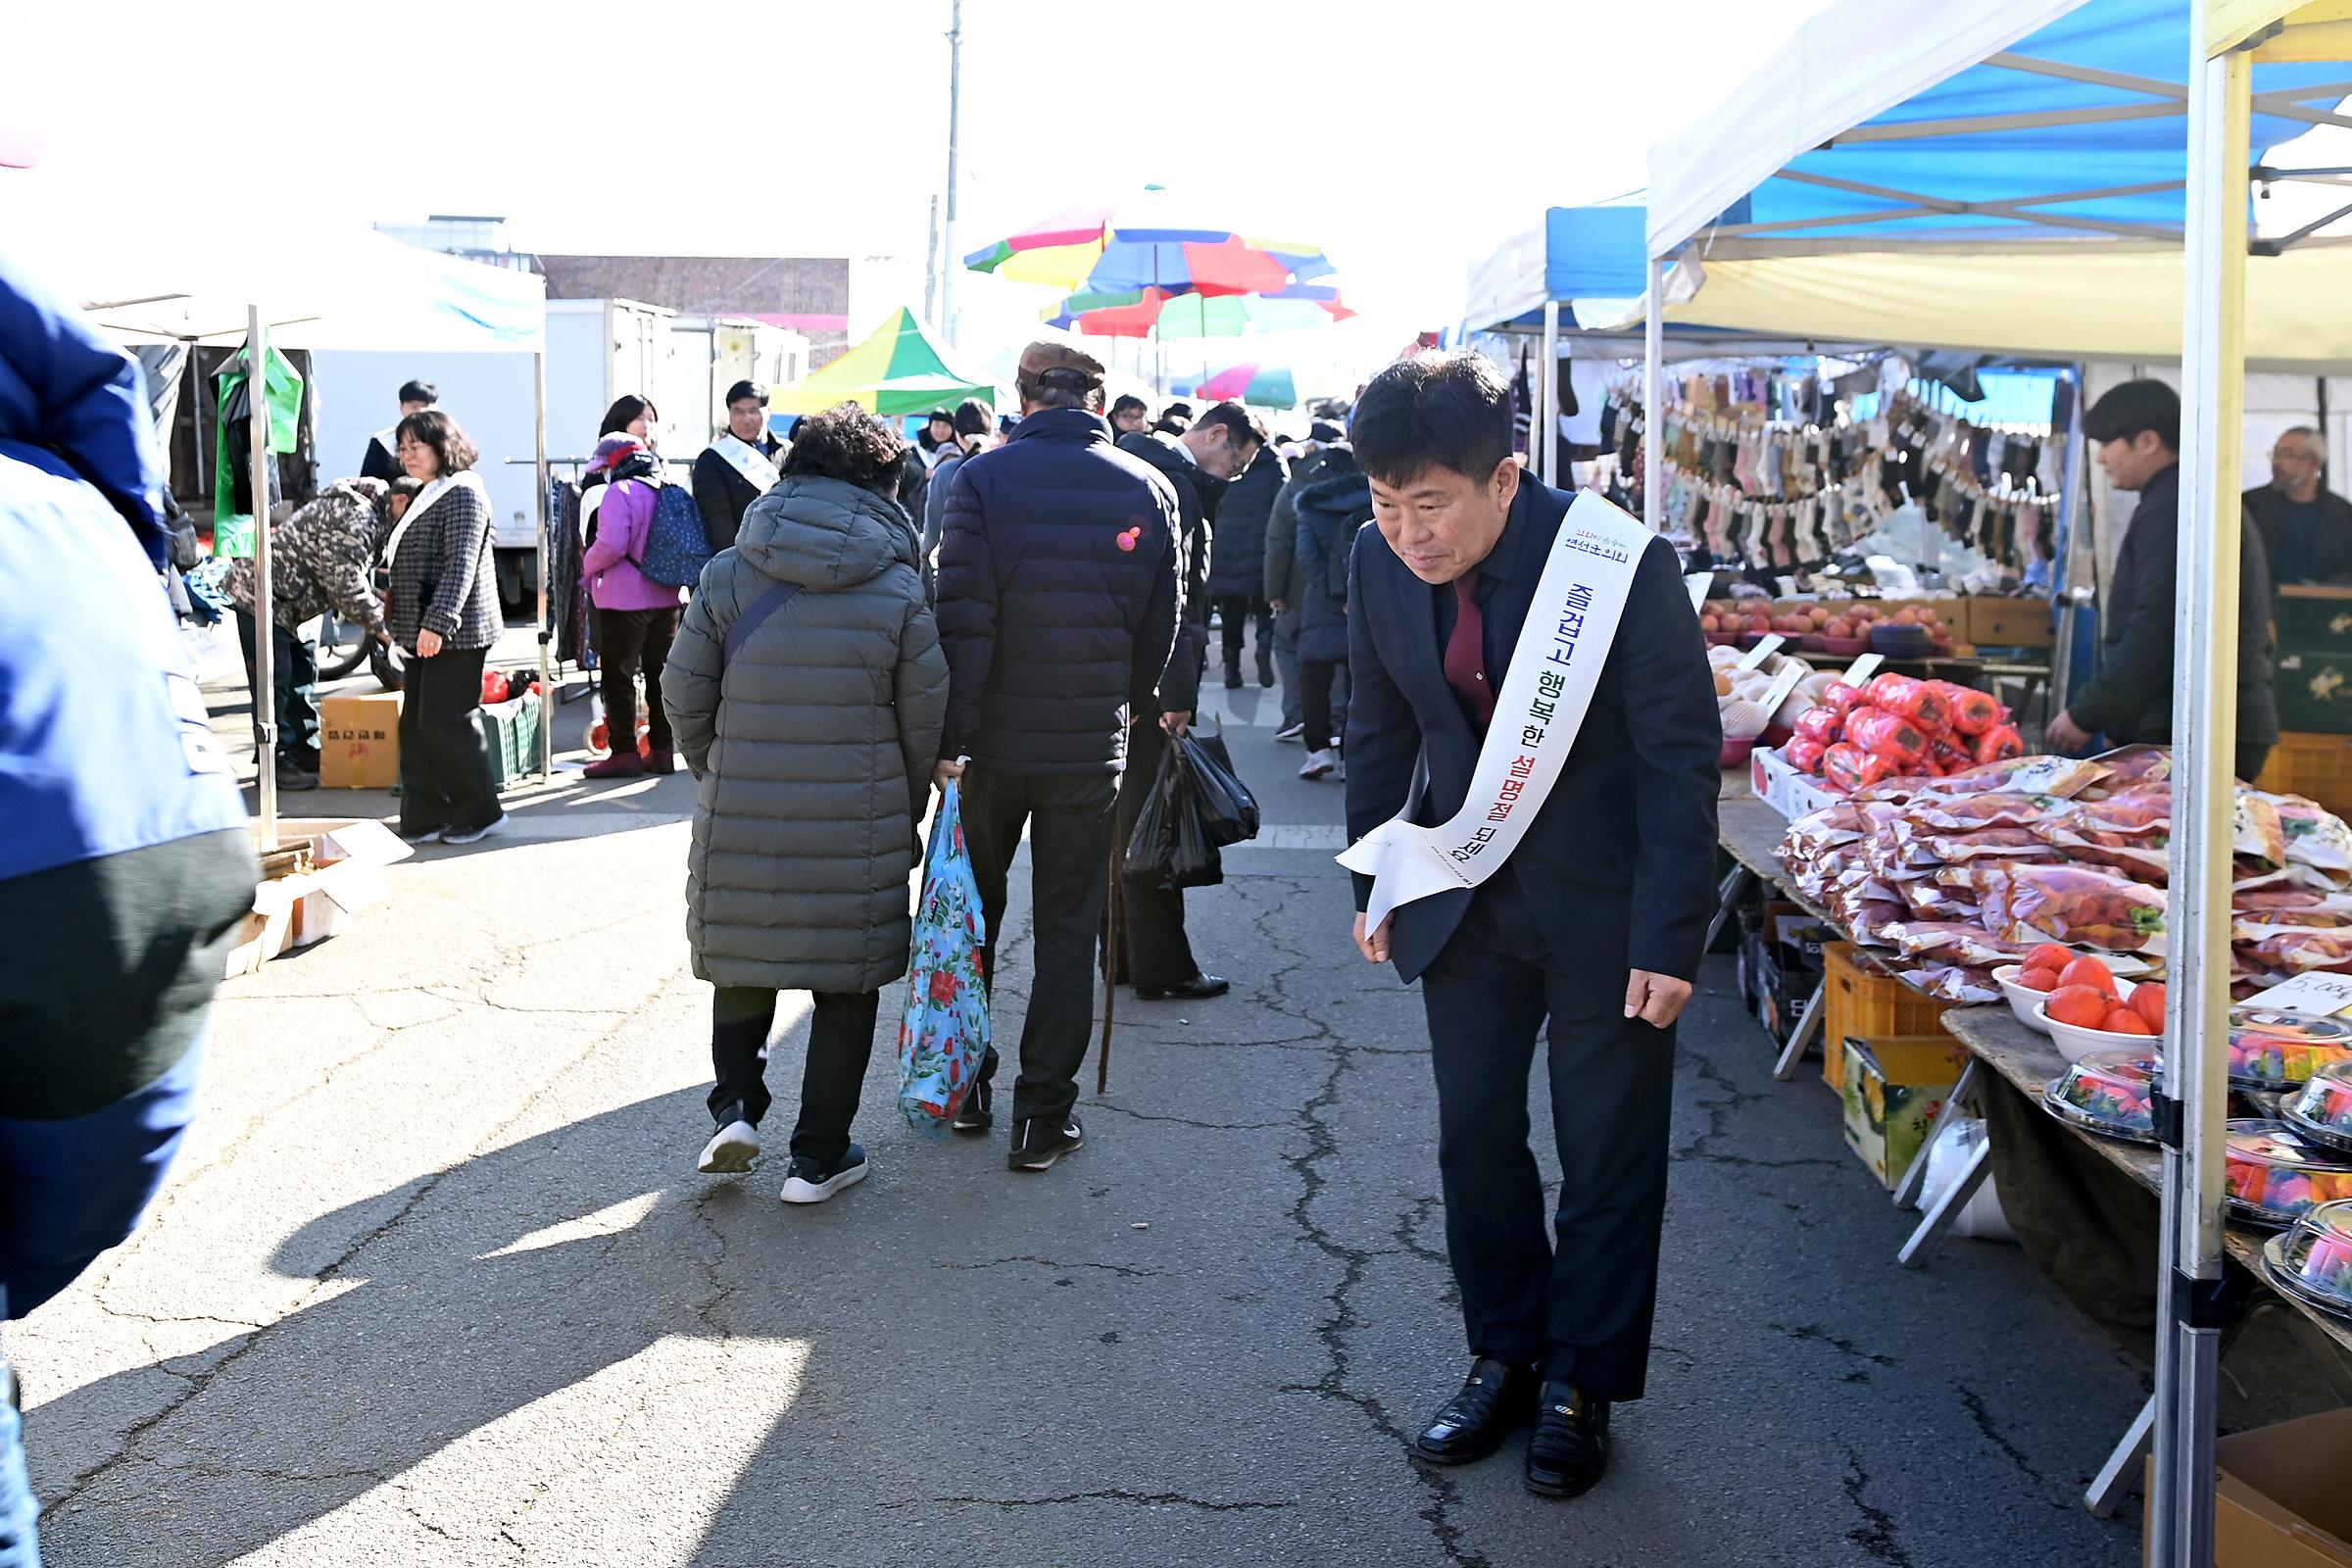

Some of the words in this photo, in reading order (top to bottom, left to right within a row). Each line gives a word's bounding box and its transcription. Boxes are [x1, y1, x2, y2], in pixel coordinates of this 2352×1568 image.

[1546, 583, 1593, 666] 즐겁고
[1521, 670, 1566, 749] 행복한
[1487, 755, 1536, 822] 설명절
[1447, 826, 1497, 863] 되세요
